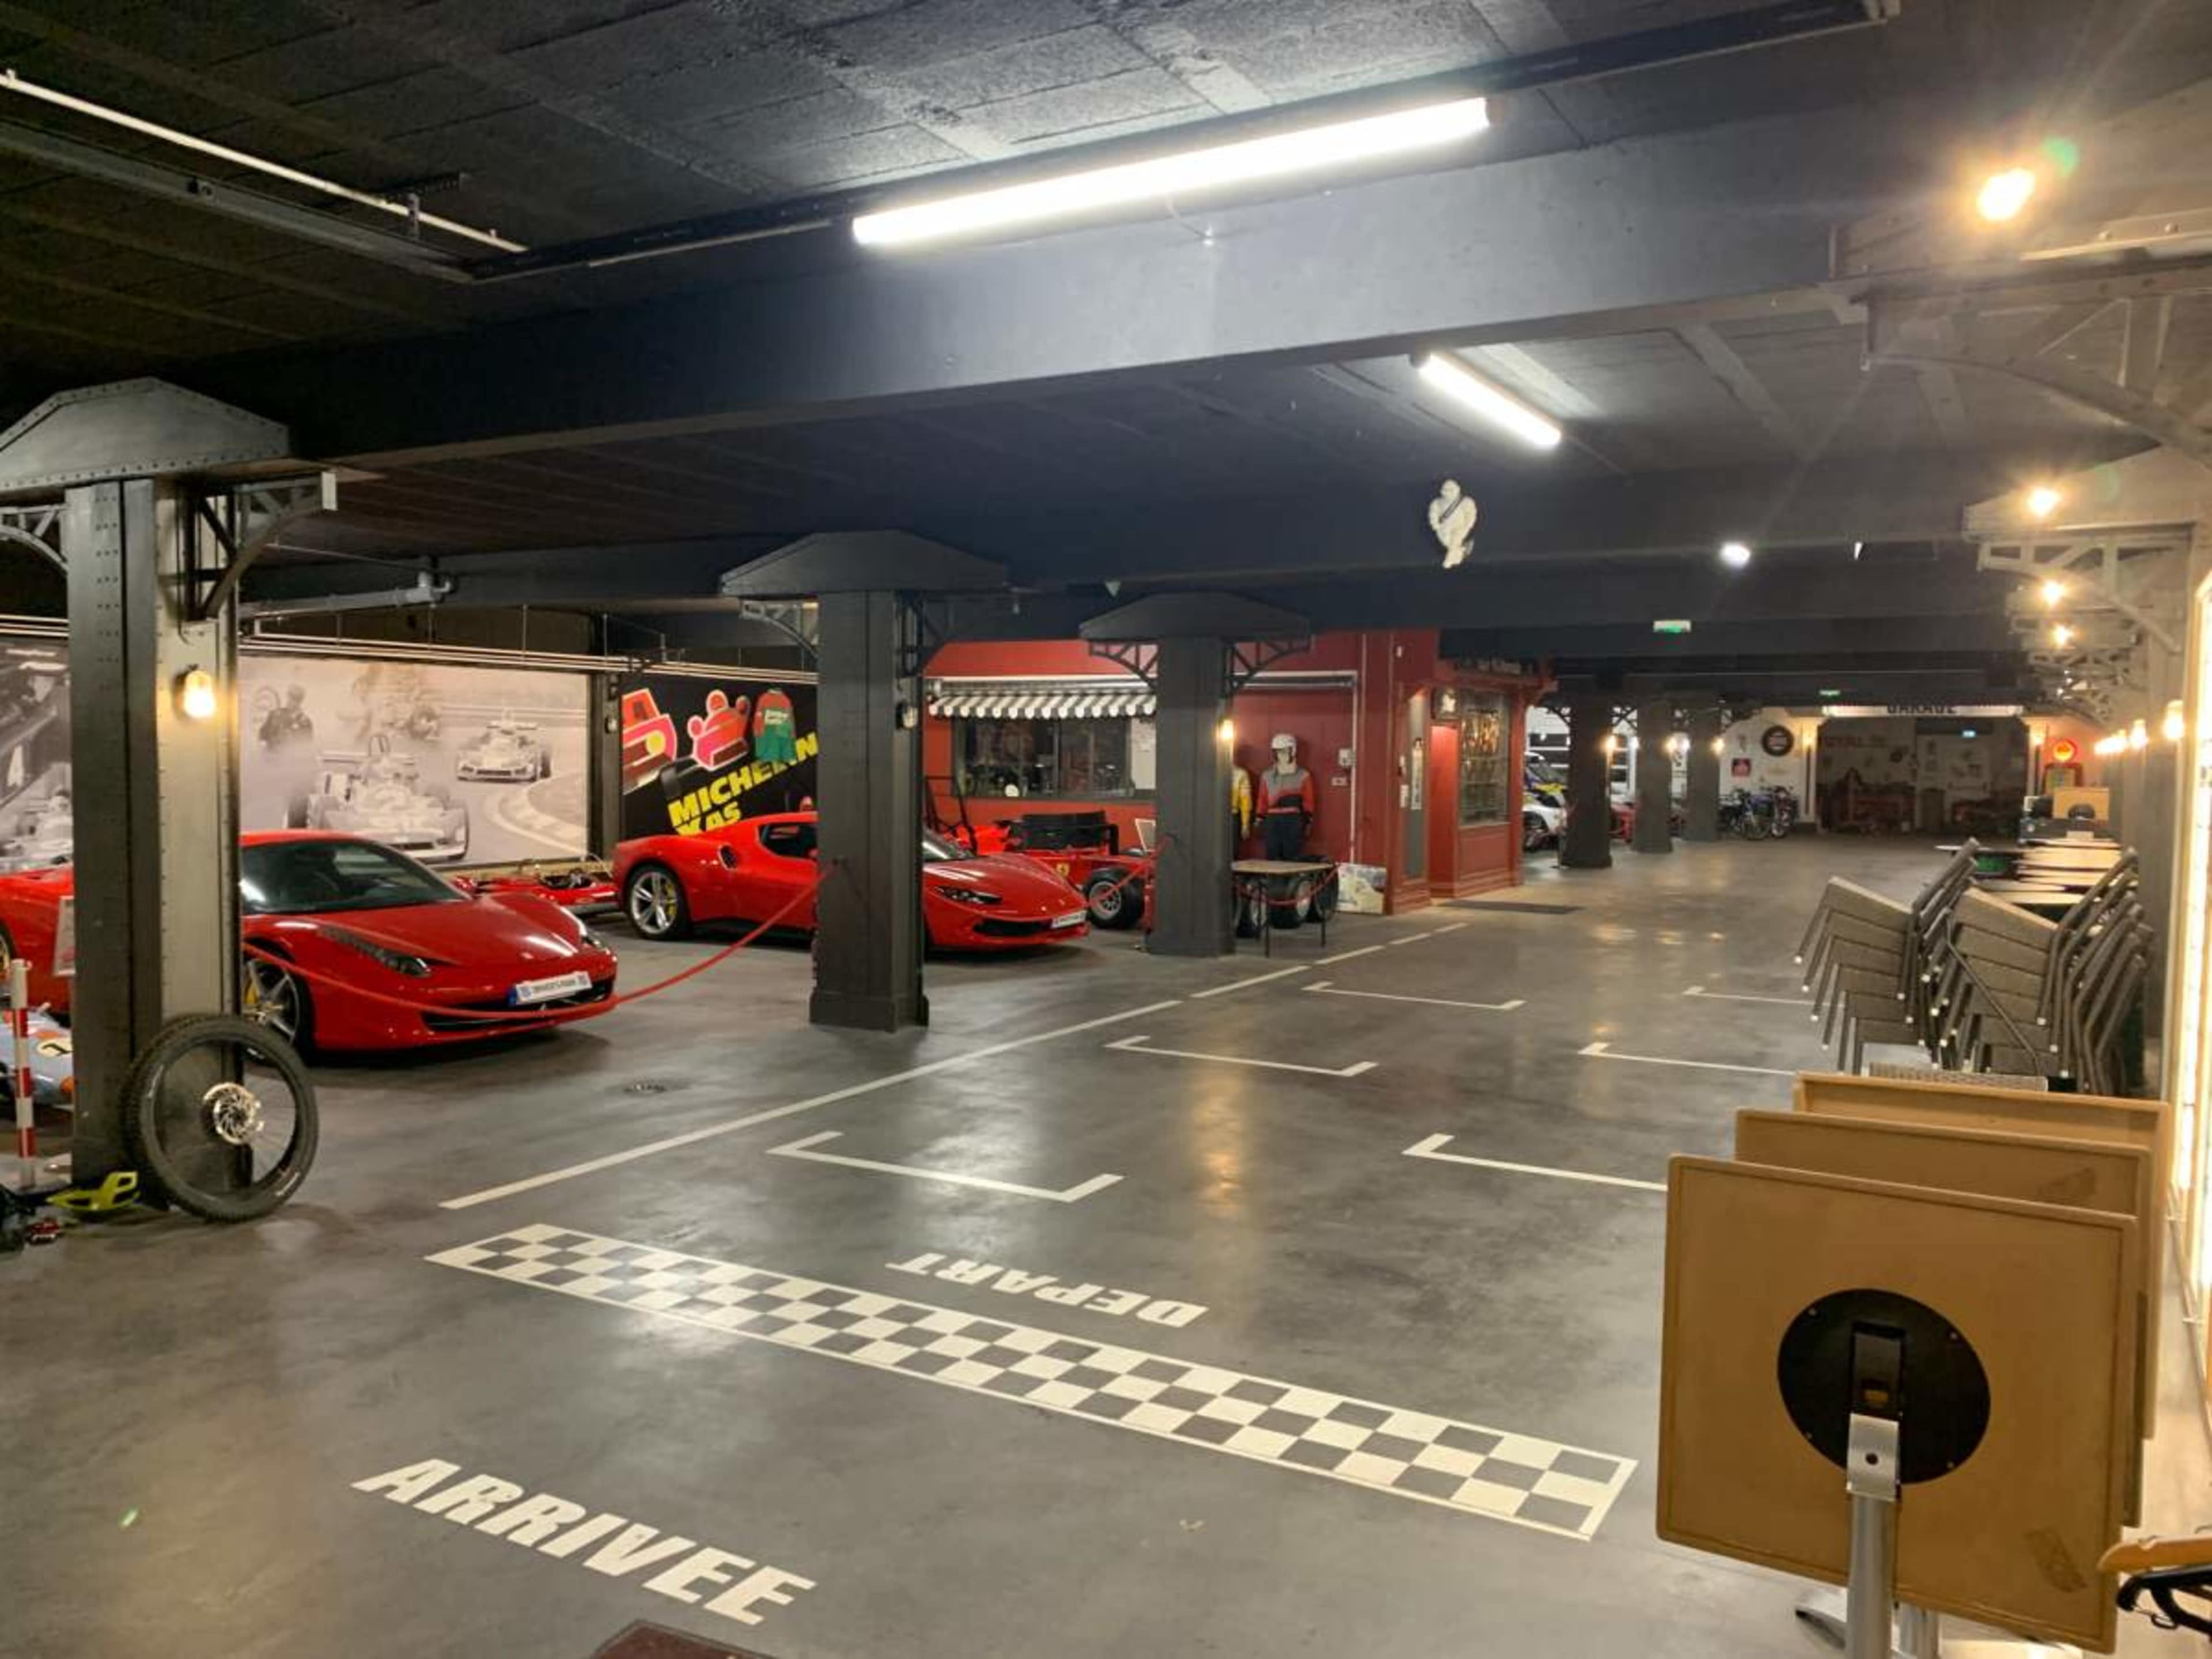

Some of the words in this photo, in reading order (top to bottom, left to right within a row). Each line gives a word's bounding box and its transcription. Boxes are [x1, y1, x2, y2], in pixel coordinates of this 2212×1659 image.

[668, 731, 819, 827] MICHEN
[885, 1252, 1209, 1327] DEPART
[350, 1458, 817, 1626] ARRIVEE
